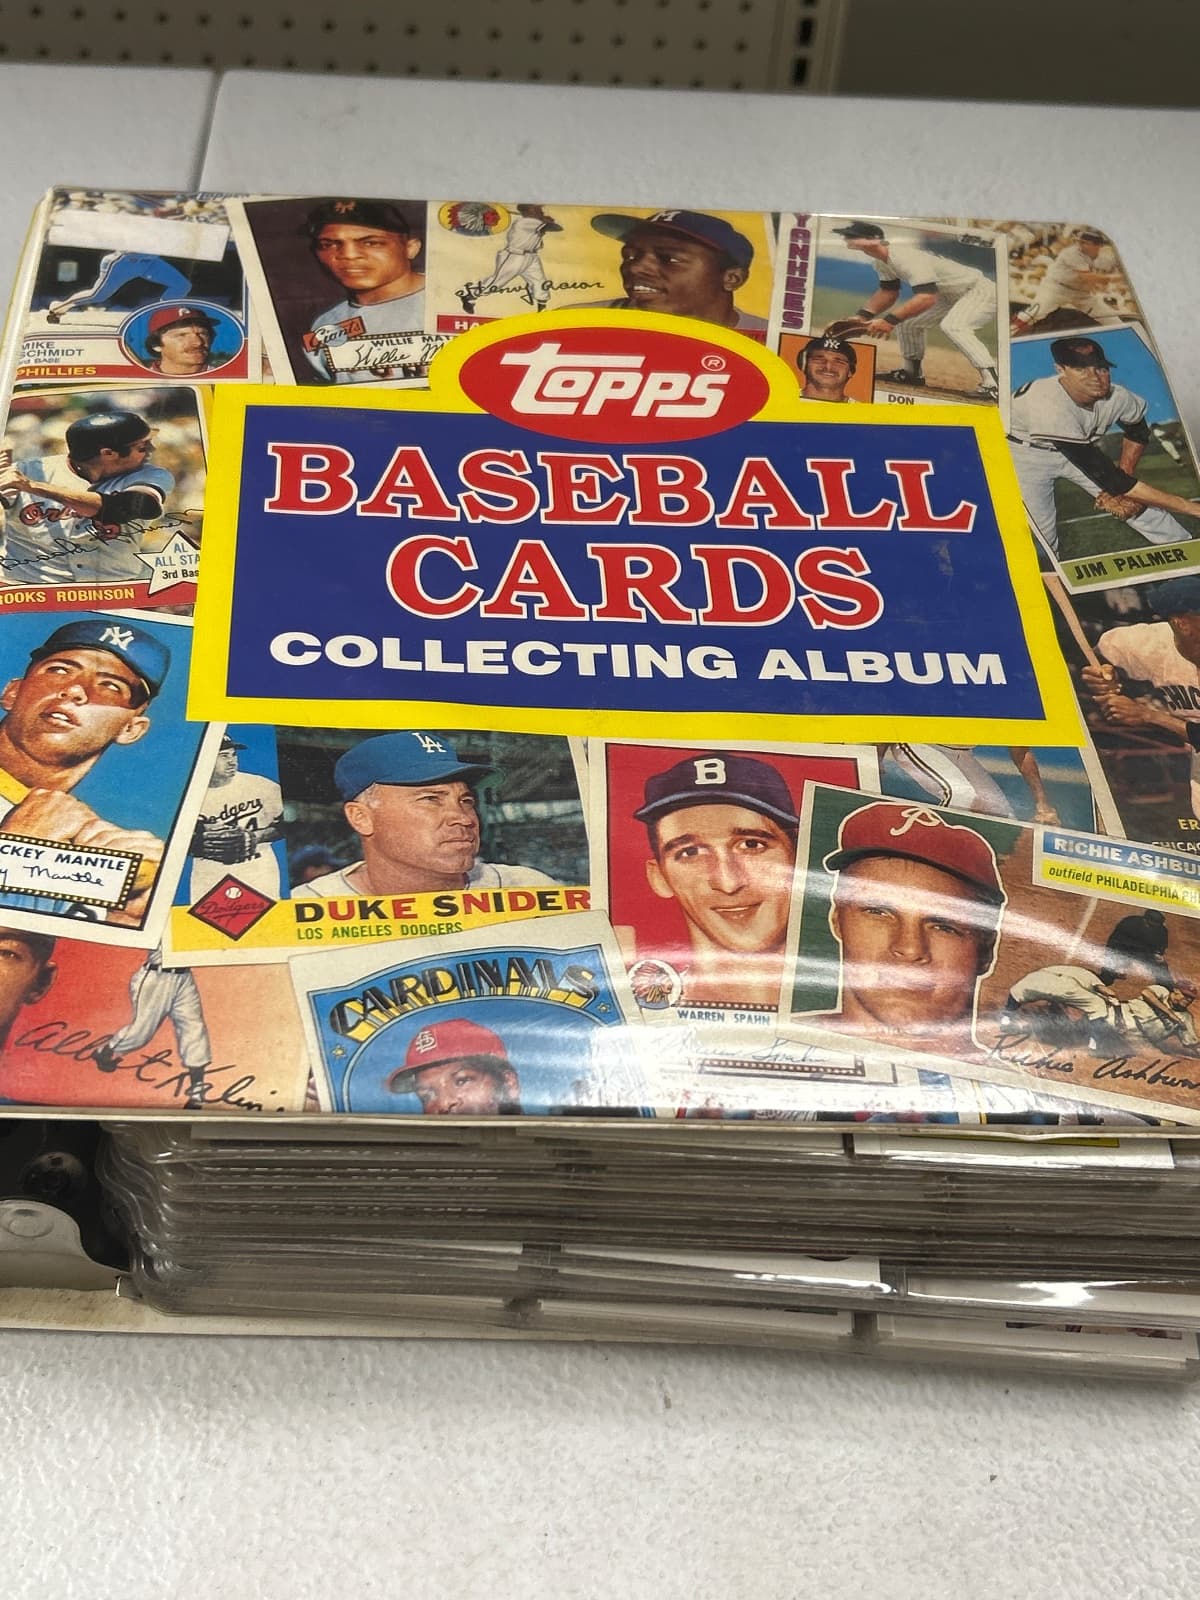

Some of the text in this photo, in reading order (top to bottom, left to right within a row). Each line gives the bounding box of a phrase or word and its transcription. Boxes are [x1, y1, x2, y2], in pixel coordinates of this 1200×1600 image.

[781, 213, 812, 330] YANKEES
[370, 336, 414, 348] WILLIE
[888, 394, 915, 406] DON
[264, 441, 977, 534] BASEBALL
[174, 542, 188, 553] AL
[154, 556, 174, 568] ALL
[1074, 548, 1188, 580] JIM PALMER
[161, 569, 179, 580] 3rd
[385, 535, 885, 631] CARDS
[56, 587, 135, 602] ROBINSON
[269, 631, 1008, 686] COLLECTING ALBUM
[411, 732, 448, 753] LA
[693, 757, 727, 786] B
[1053, 836, 1123, 862] RICHIE
[54, 853, 127, 871] MANTLE
[1048, 866, 1093, 883] outfield
[1095, 874, 1180, 900] PHILADELPHIA
[295, 888, 592, 924] DUKE SNIDER
[297, 921, 463, 941] LOS ANGELES DODGERS
[330, 956, 598, 1042] CARDINALS
[677, 1009, 771, 1026] WARREN SPAHN
